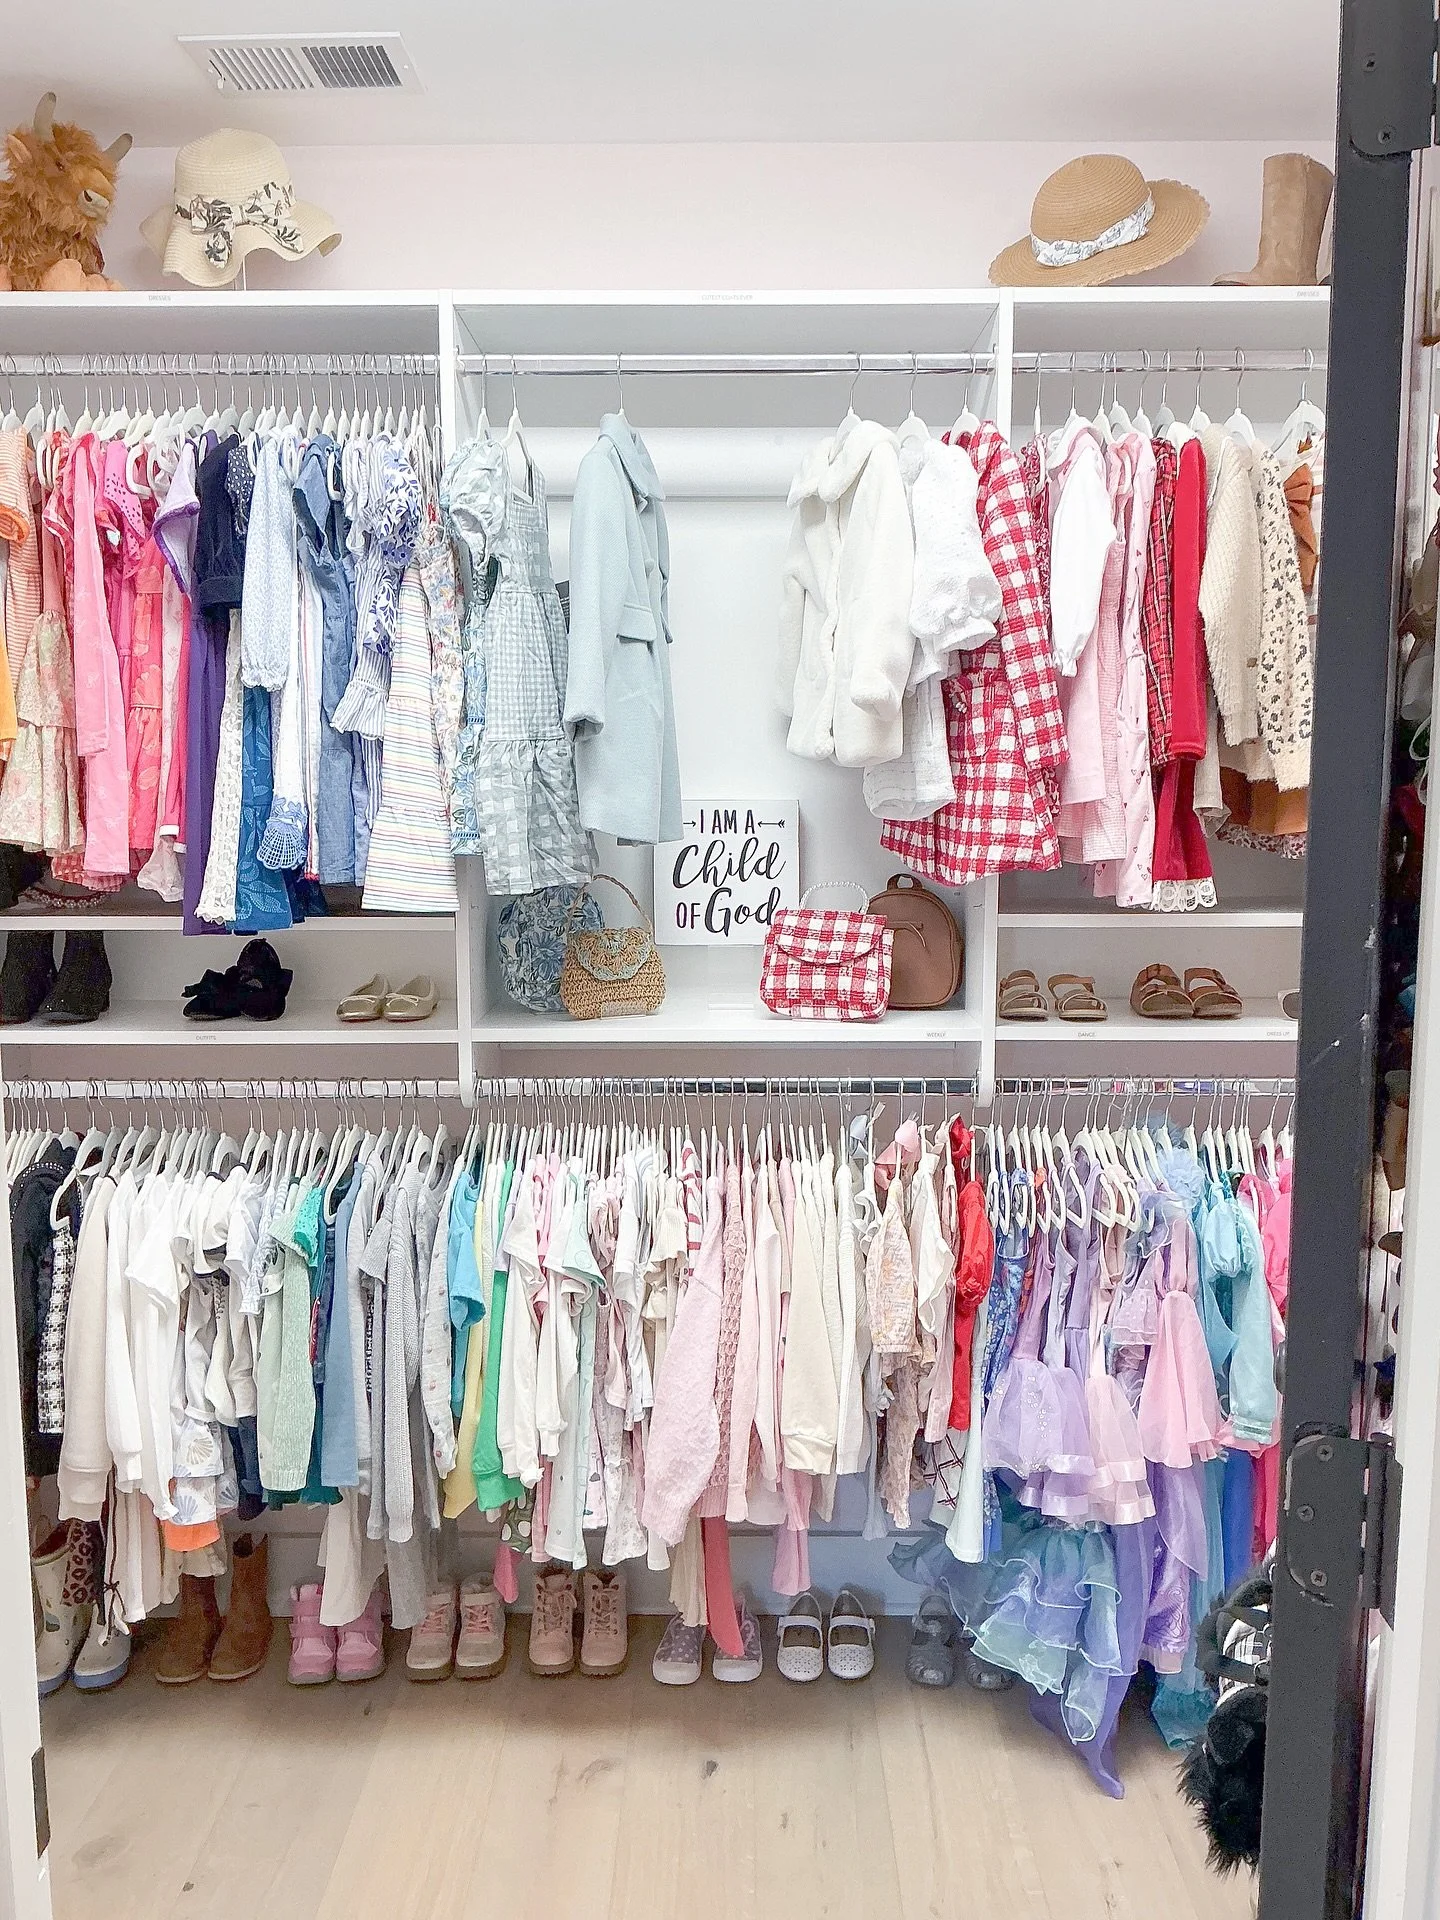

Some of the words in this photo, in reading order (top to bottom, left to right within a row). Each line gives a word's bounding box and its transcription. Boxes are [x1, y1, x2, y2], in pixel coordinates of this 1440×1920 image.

[699, 809, 704, 834] I
[711, 809, 737, 834] AM
[744, 809, 755, 834] A
[672, 837, 786, 889] Child
[676, 902, 701, 929] OF
[704, 887, 783, 937] God
